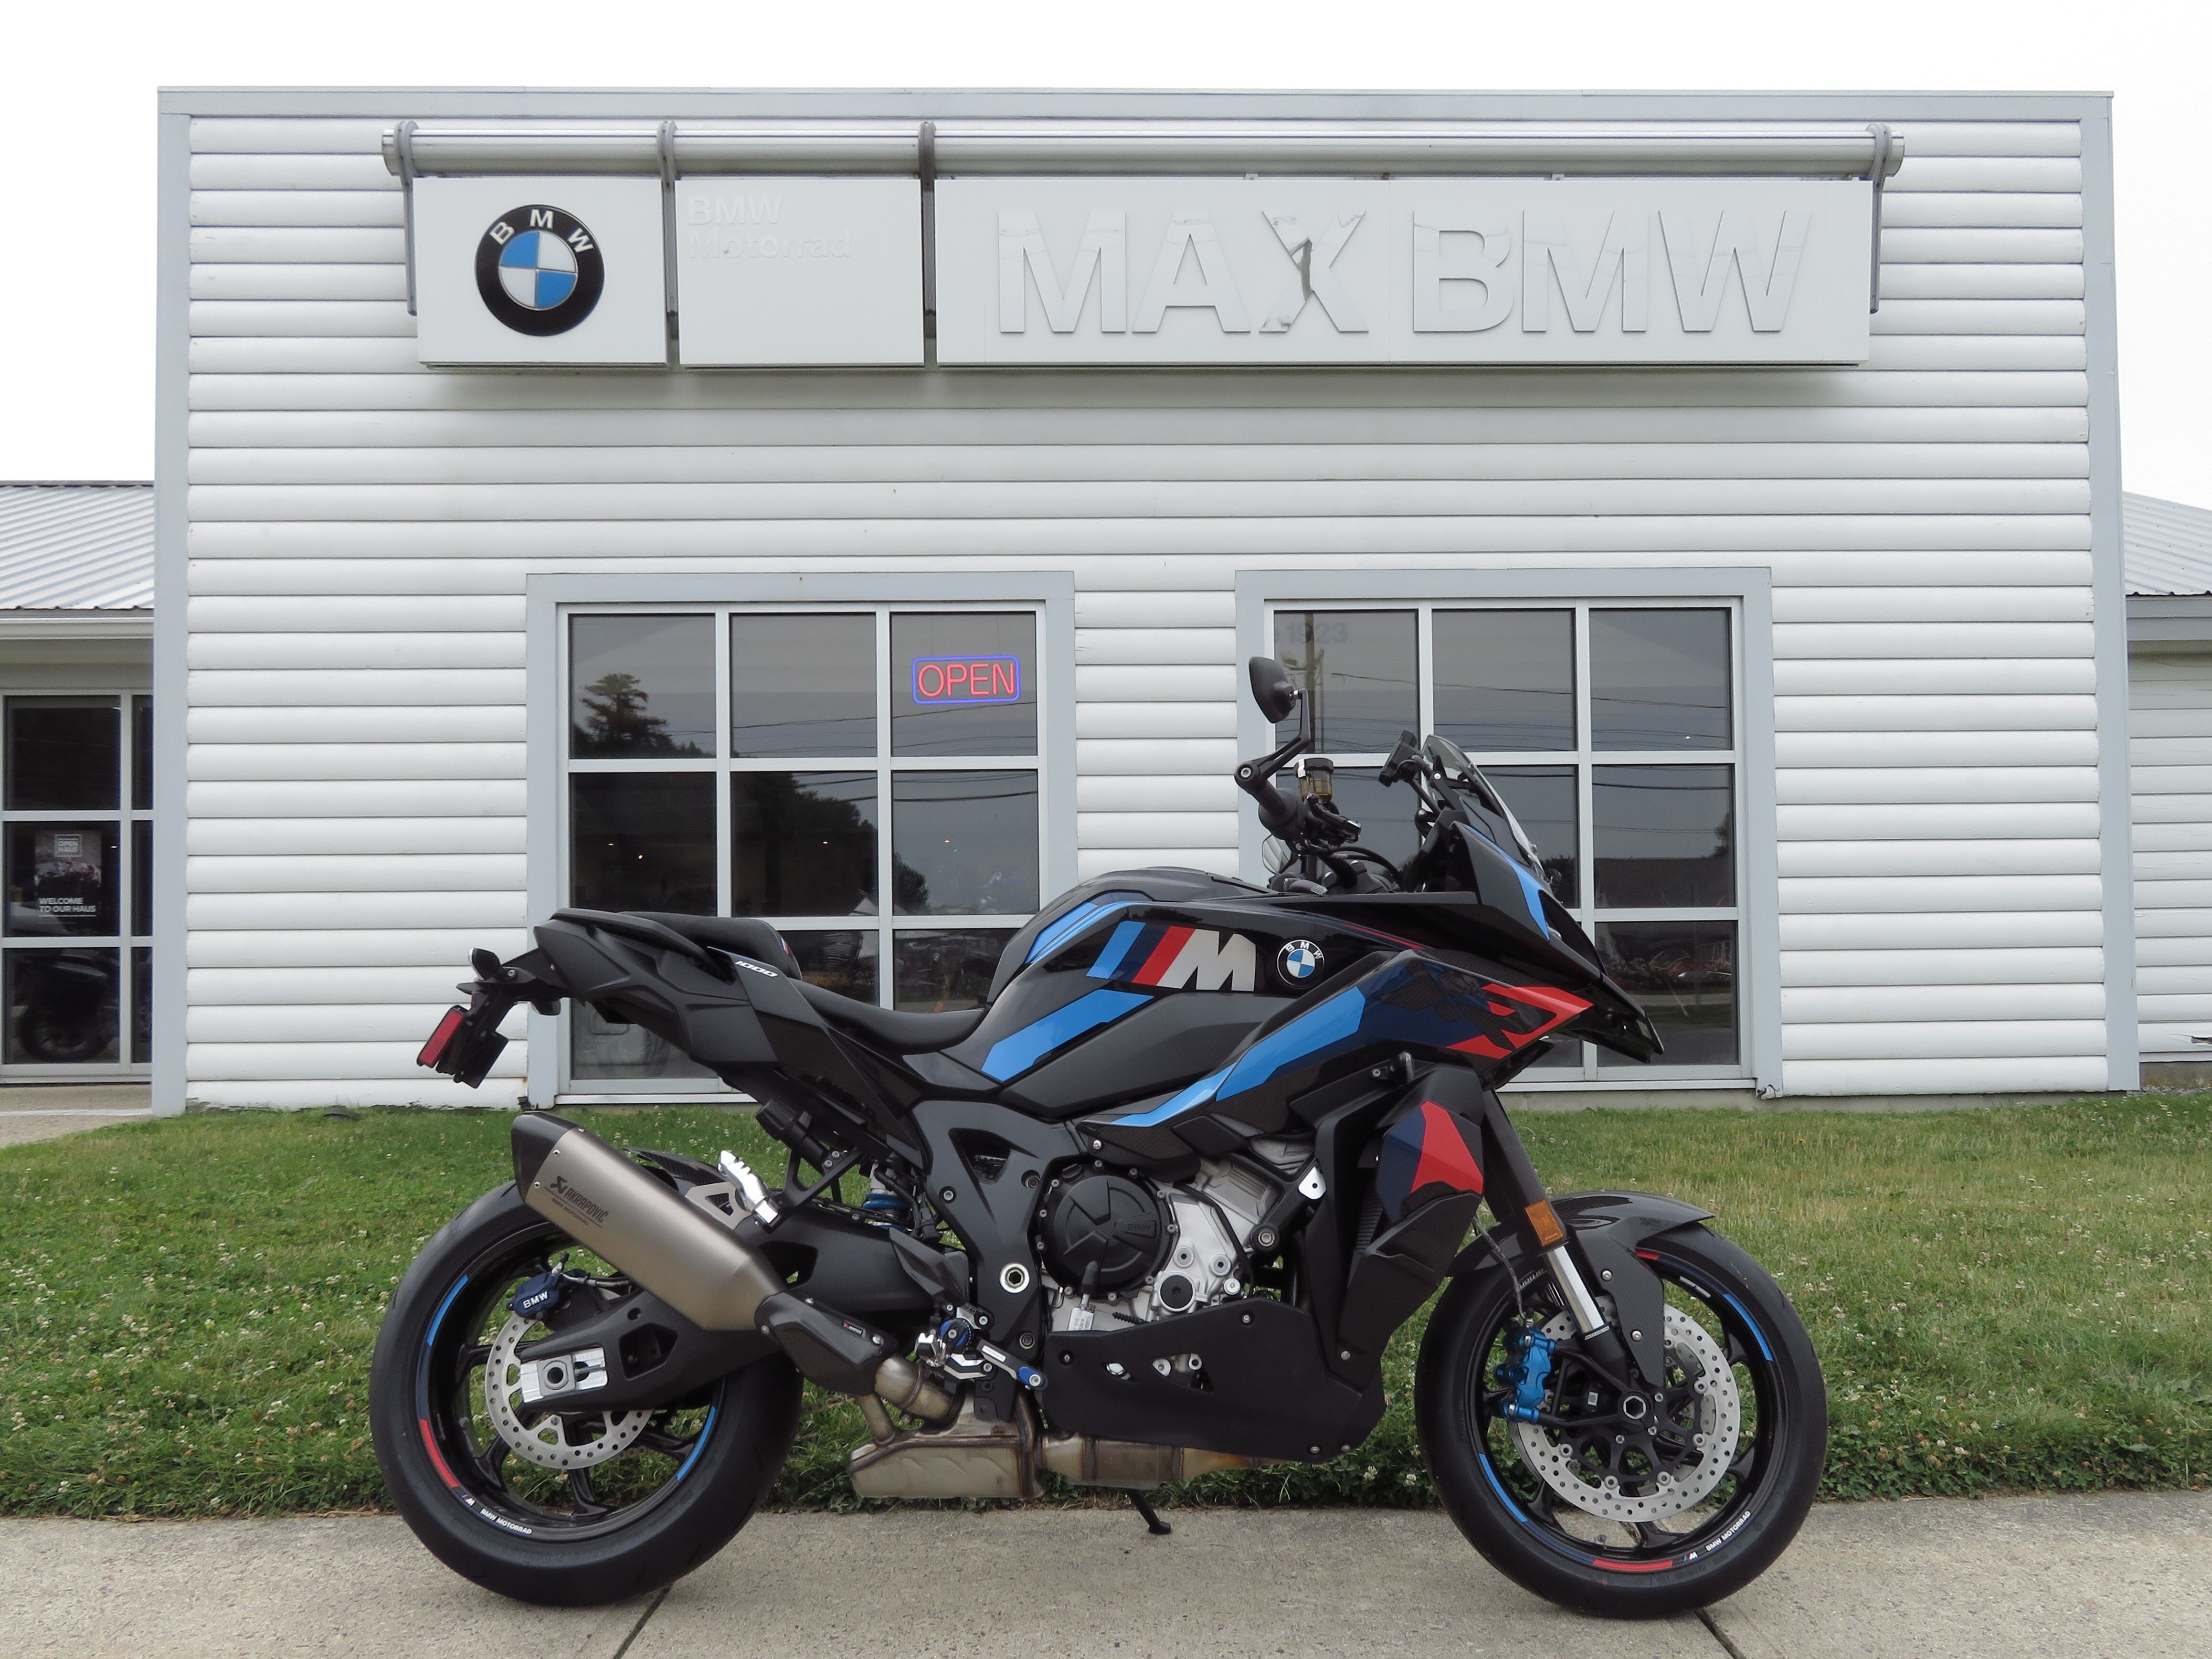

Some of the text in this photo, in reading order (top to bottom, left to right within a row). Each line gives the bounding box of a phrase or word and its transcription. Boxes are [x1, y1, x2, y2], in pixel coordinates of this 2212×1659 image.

[688, 194, 782, 225] BMW
[489, 209, 595, 254] BMW
[689, 229, 852, 259] Motorrad
[998, 210, 1812, 333] MAX BMW
[918, 662, 1015, 697] OPEN
[1156, 929, 1257, 992] M
[1285, 941, 1323, 960] BMW
[734, 961, 779, 977] 1000
[522, 1290, 549, 1310] BMW
[480, 1508, 533, 1535] BMW MOTORRAD
[1705, 1510, 1751, 1552] BMW MOTORRAD
